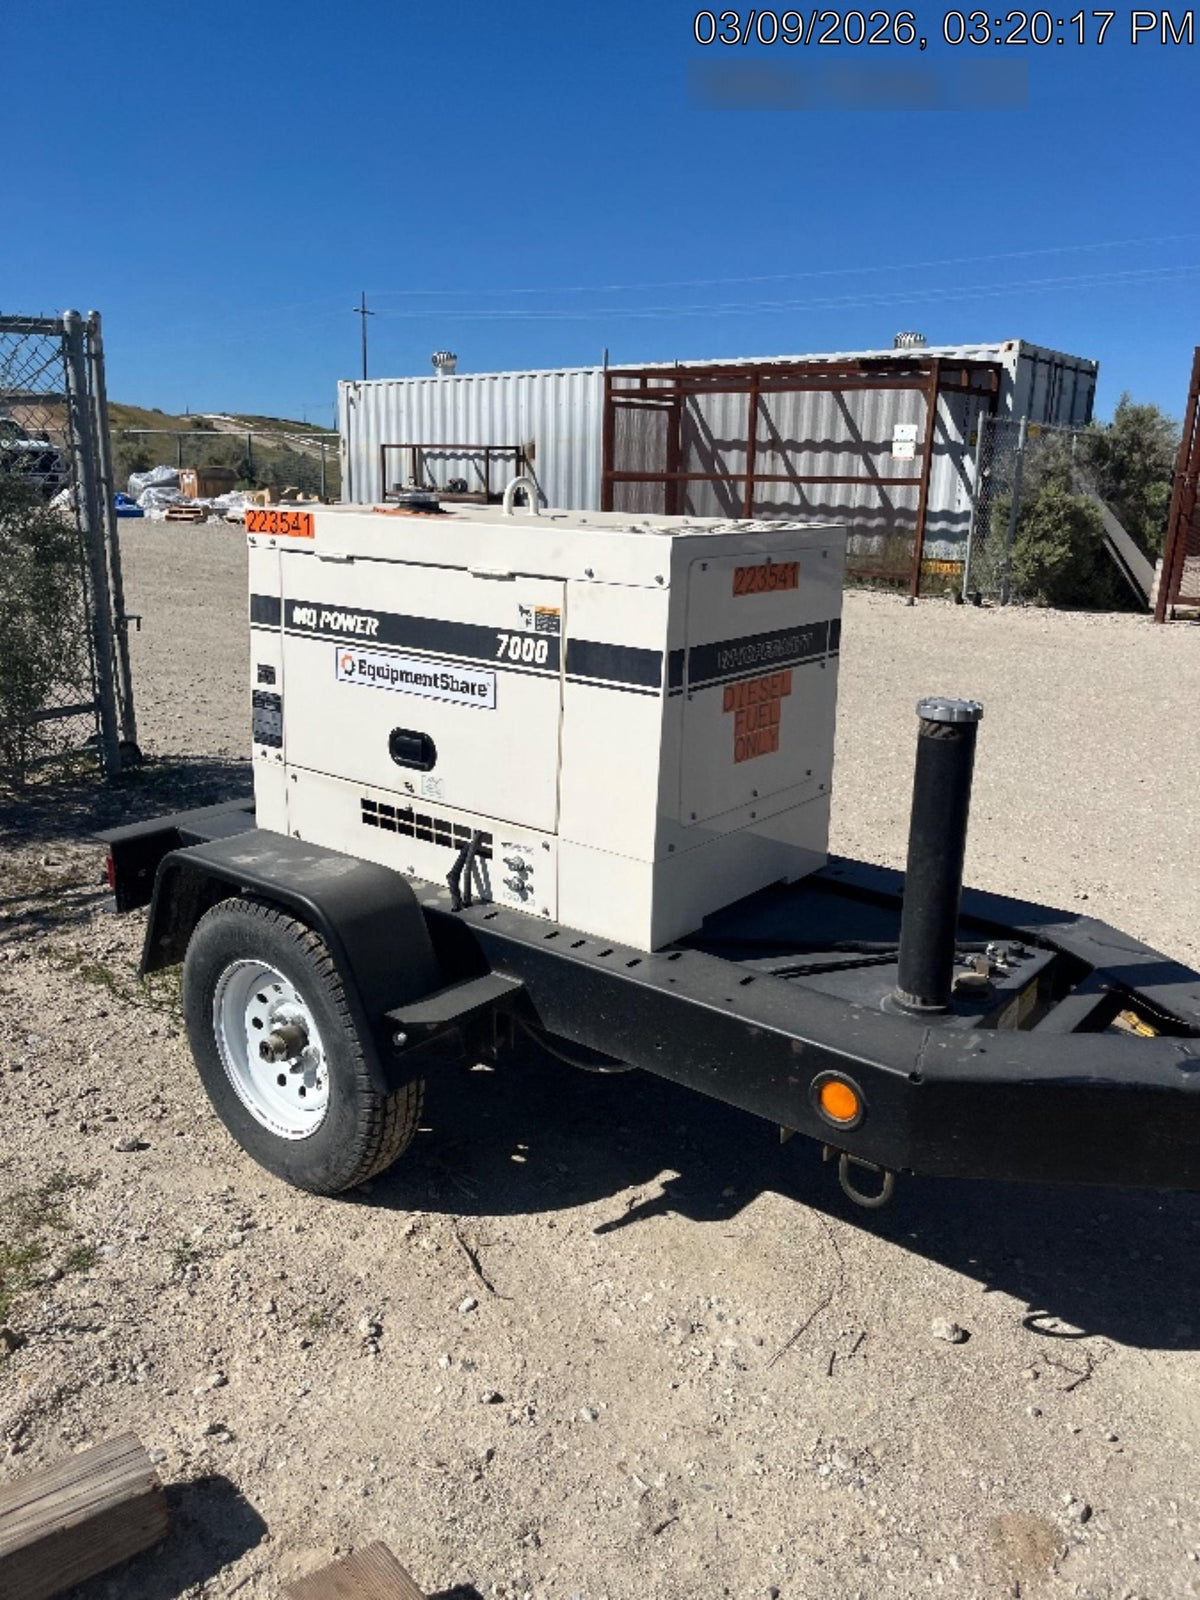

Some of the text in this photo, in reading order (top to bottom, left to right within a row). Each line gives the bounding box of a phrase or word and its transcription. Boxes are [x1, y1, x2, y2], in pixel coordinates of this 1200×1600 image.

[247, 509, 312, 536] 223541
[734, 562, 799, 595] 223541
[293, 606, 379, 636] MQ POWER
[496, 634, 549, 664] 7000
[358, 659, 488, 698] EquipmentShare
[724, 671, 791, 712] DIESEL
[736, 701, 780, 735] FUEL
[735, 728, 779, 763] ONLY
